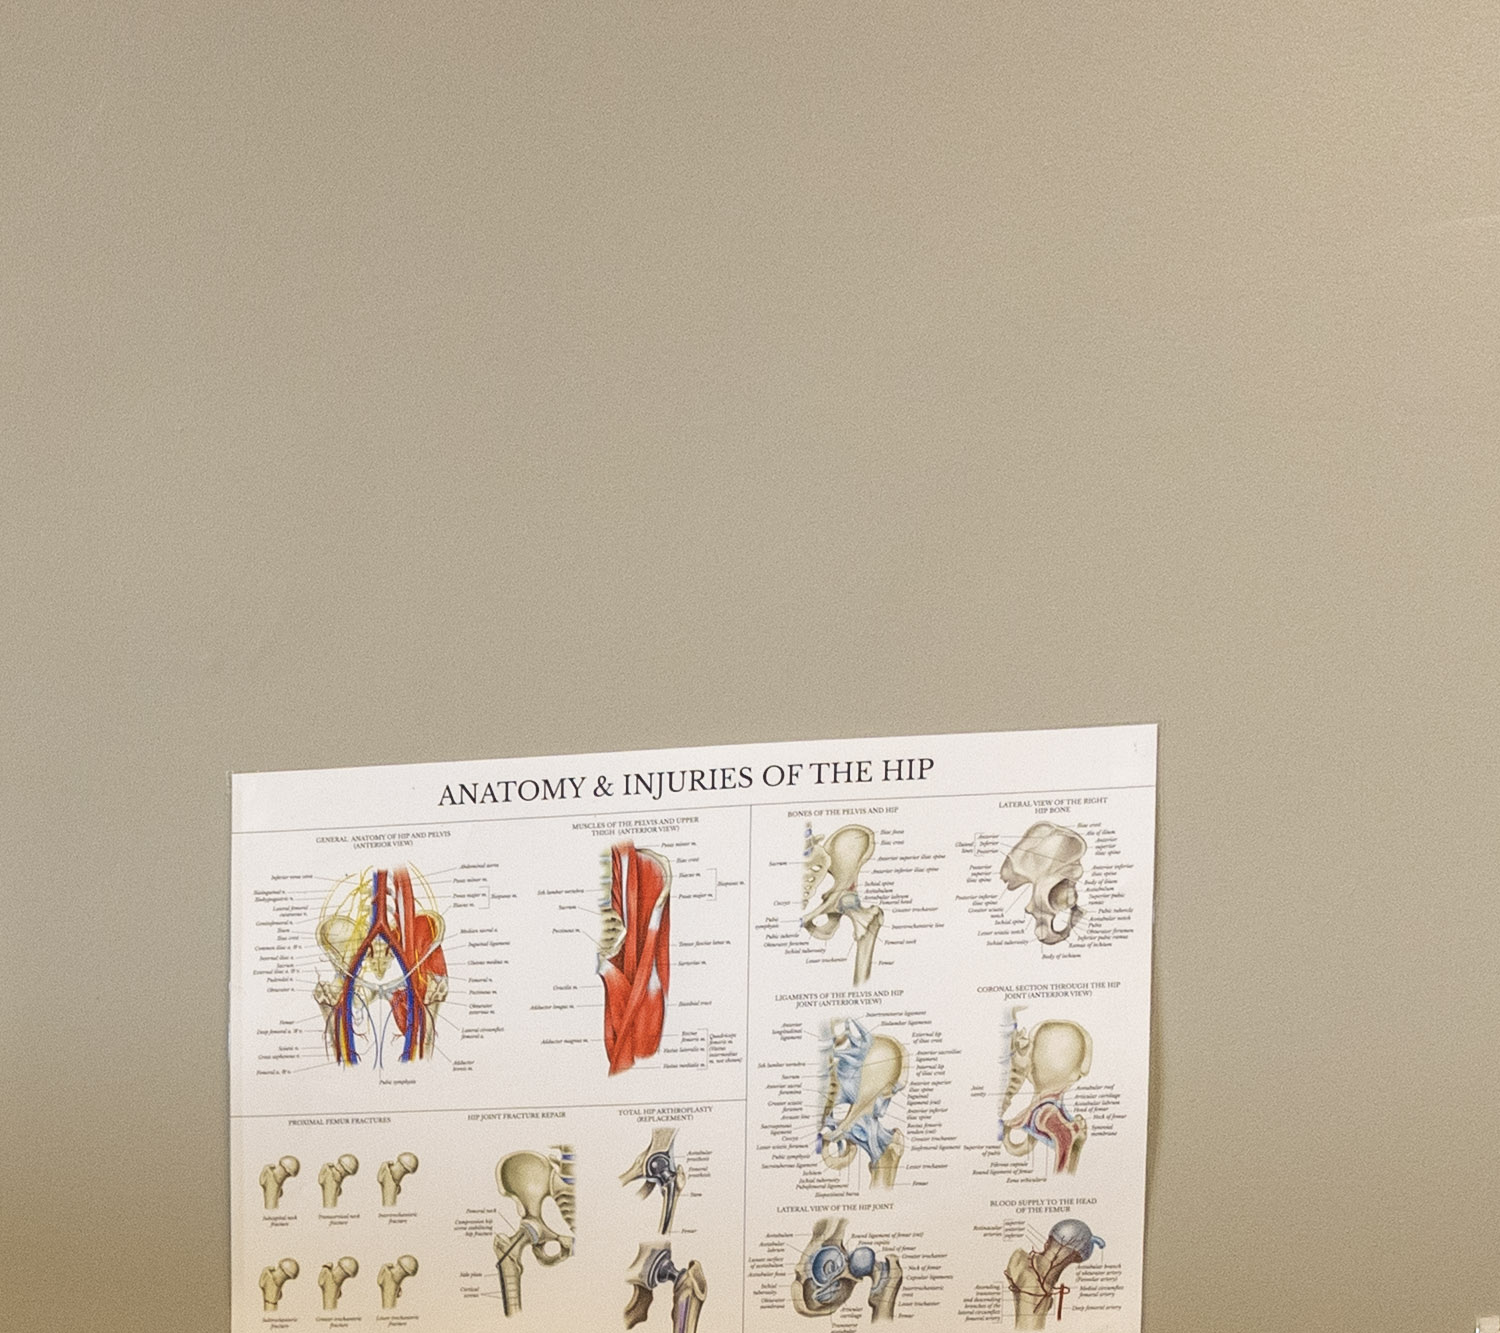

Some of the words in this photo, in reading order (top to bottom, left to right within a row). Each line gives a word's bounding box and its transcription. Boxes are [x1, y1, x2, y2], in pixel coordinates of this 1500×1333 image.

[438, 776, 587, 806] ANATOMY
[593, 776, 615, 798] &
[623, 767, 753, 799] INJURIES
[762, 764, 803, 787] OF
[808, 760, 874, 785] THE
[881, 758, 936, 782] HIP
[998, 800, 1032, 808] LATERAL
[1049, 806, 1071, 814] BONE
[572, 822, 605, 830] MUSCLES
[618, 820, 632, 828] THE
[618, 827, 657, 836] (ANTERIOR
[353, 842, 391, 850] (ANTERIOR
[977, 985, 1014, 993] CORONAL
[1015, 984, 1048, 992] SECTION
[1107, 981, 1121, 989] HIP
[775, 993, 818, 1001] LIGAMENTS
[1004, 992, 1027, 1000] JOINT
[1028, 990, 1069, 999] (ANTERIOR
[796, 1001, 817, 1009] JOINT
[819, 999, 859, 1007] (ANTERIOR
[860, 998, 882, 1006] VIEW)
[656, 1106, 713, 1114] ARTHROPLASTY
[636, 1114, 694, 1123] (REPLACEMENT)
[777, 1205, 810, 1213] LATERAL
[871, 1203, 893, 1211] JOINT
